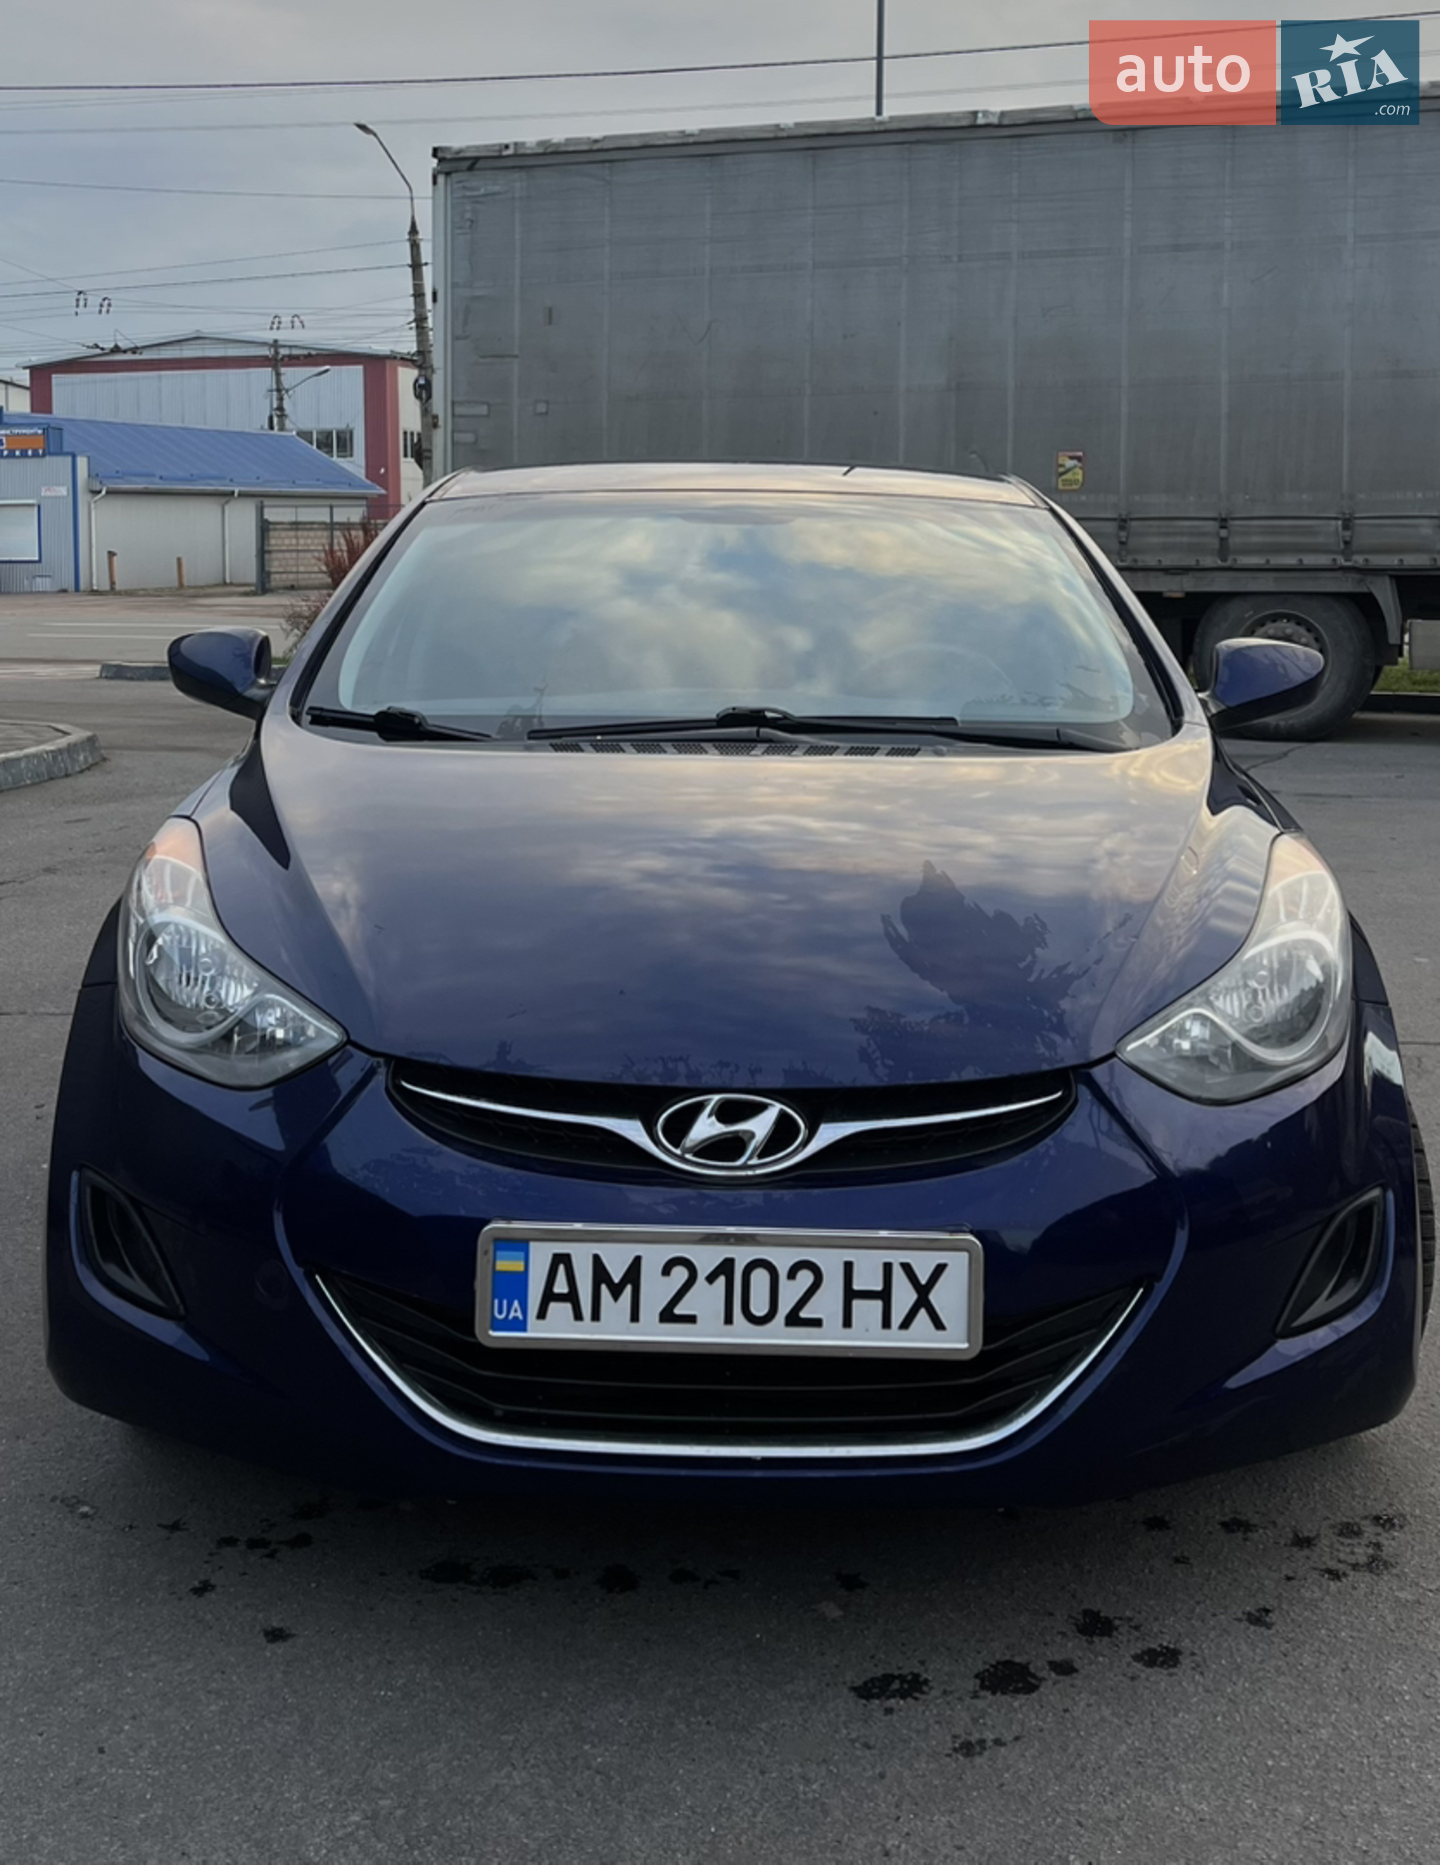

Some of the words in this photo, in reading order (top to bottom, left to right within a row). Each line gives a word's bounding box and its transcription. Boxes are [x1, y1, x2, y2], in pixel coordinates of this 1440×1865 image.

[494, 1298, 523, 1320] UA
[535, 1252, 643, 1323] AM
[658, 1255, 825, 1329] 2102
[843, 1260, 949, 1331] HX
